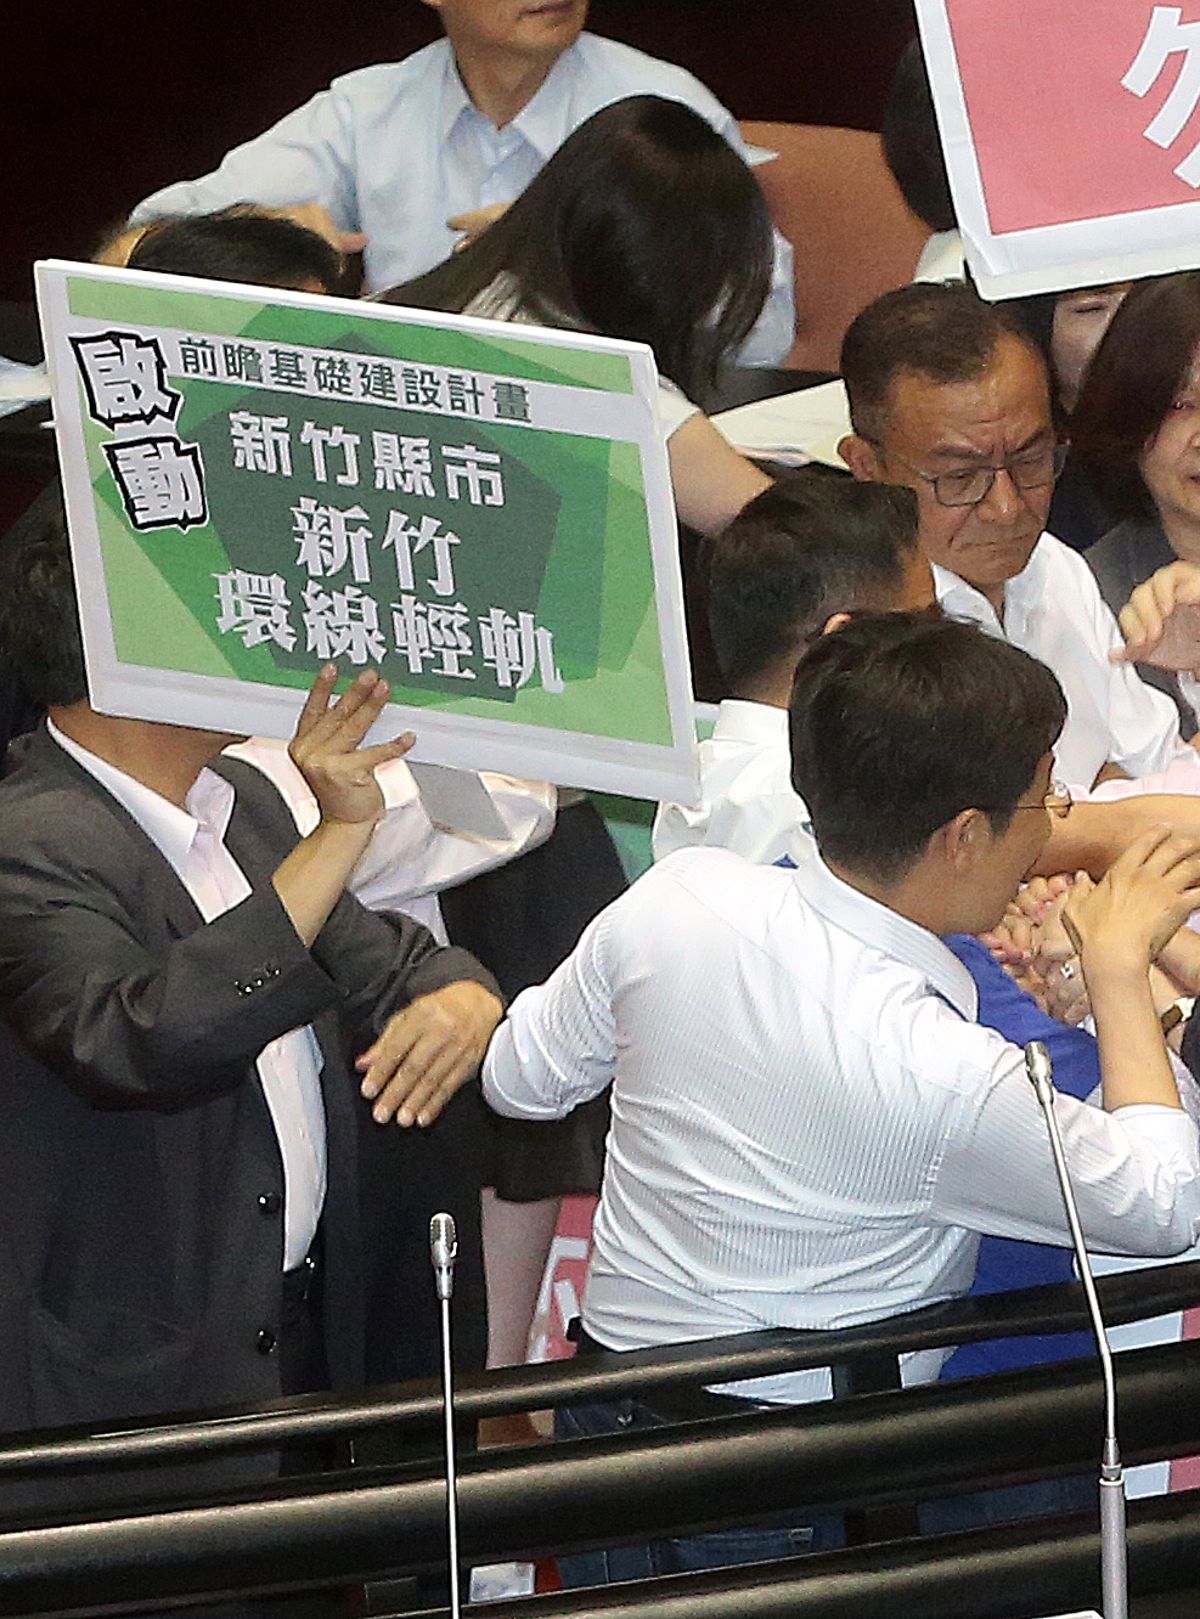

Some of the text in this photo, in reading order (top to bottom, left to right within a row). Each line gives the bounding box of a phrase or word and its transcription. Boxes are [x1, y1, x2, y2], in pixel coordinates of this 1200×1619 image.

[178, 336, 533, 423] 前瞻基礎建設計畫
[69, 331, 208, 531] 啟動
[228, 409, 506, 507] 新竹縣市
[289, 495, 461, 597] 新竹
[210, 567, 568, 694] 環線輕軌
